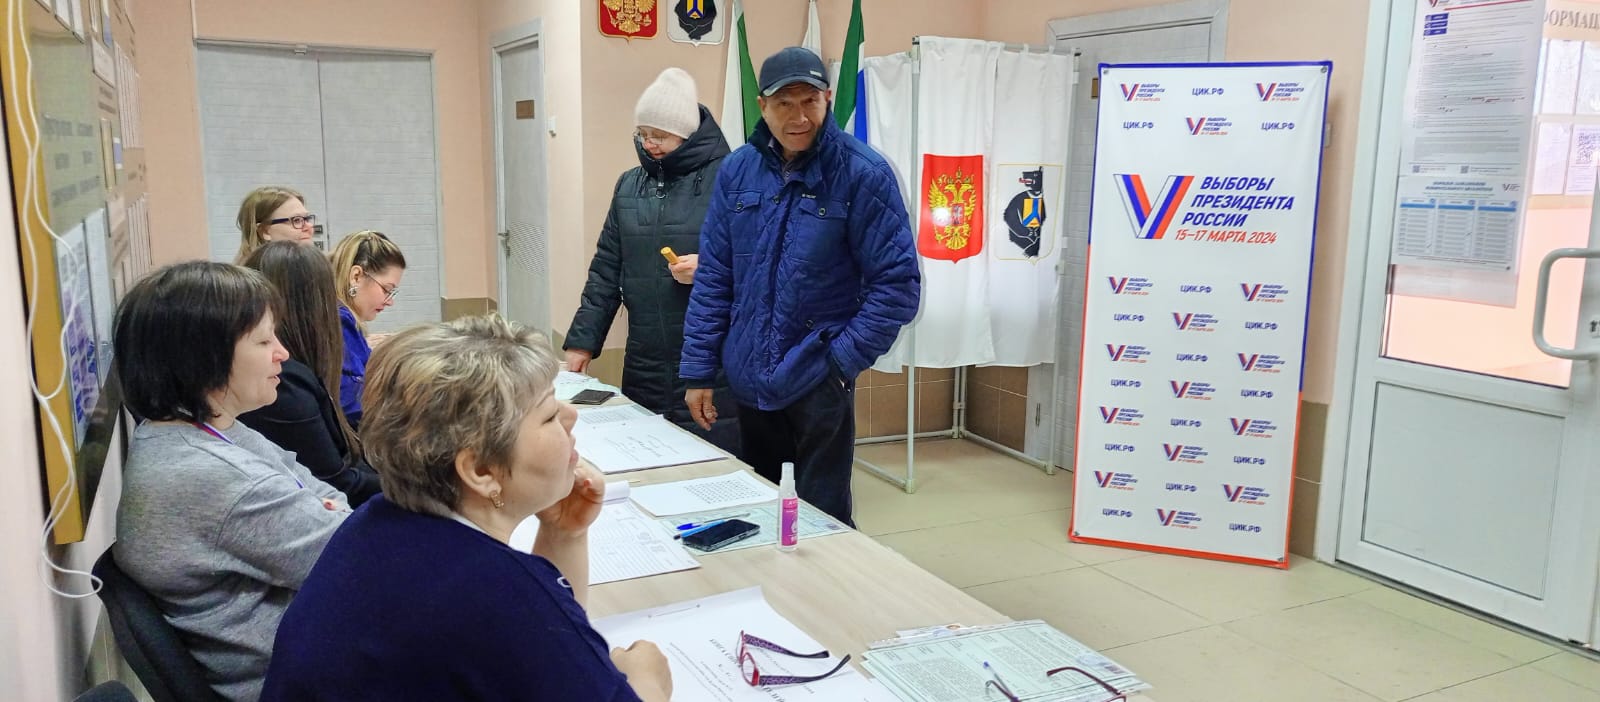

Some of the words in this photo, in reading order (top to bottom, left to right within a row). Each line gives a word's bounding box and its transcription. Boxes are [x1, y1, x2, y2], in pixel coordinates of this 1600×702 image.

[1192, 88, 1224, 96] ЦИК.РФ
[1123, 122, 1154, 130] ЦИК.РФ
[1261, 122, 1295, 131] ЦИК.РФ
[1200, 176, 1275, 191] ВЫБОРЫ
[1190, 194, 1295, 212] ПРЕЗИДЕНТА
[1181, 212, 1248, 227] РОССИИ
[1208, 230, 1247, 243] МАРТА
[1248, 232, 1277, 244] 2024
